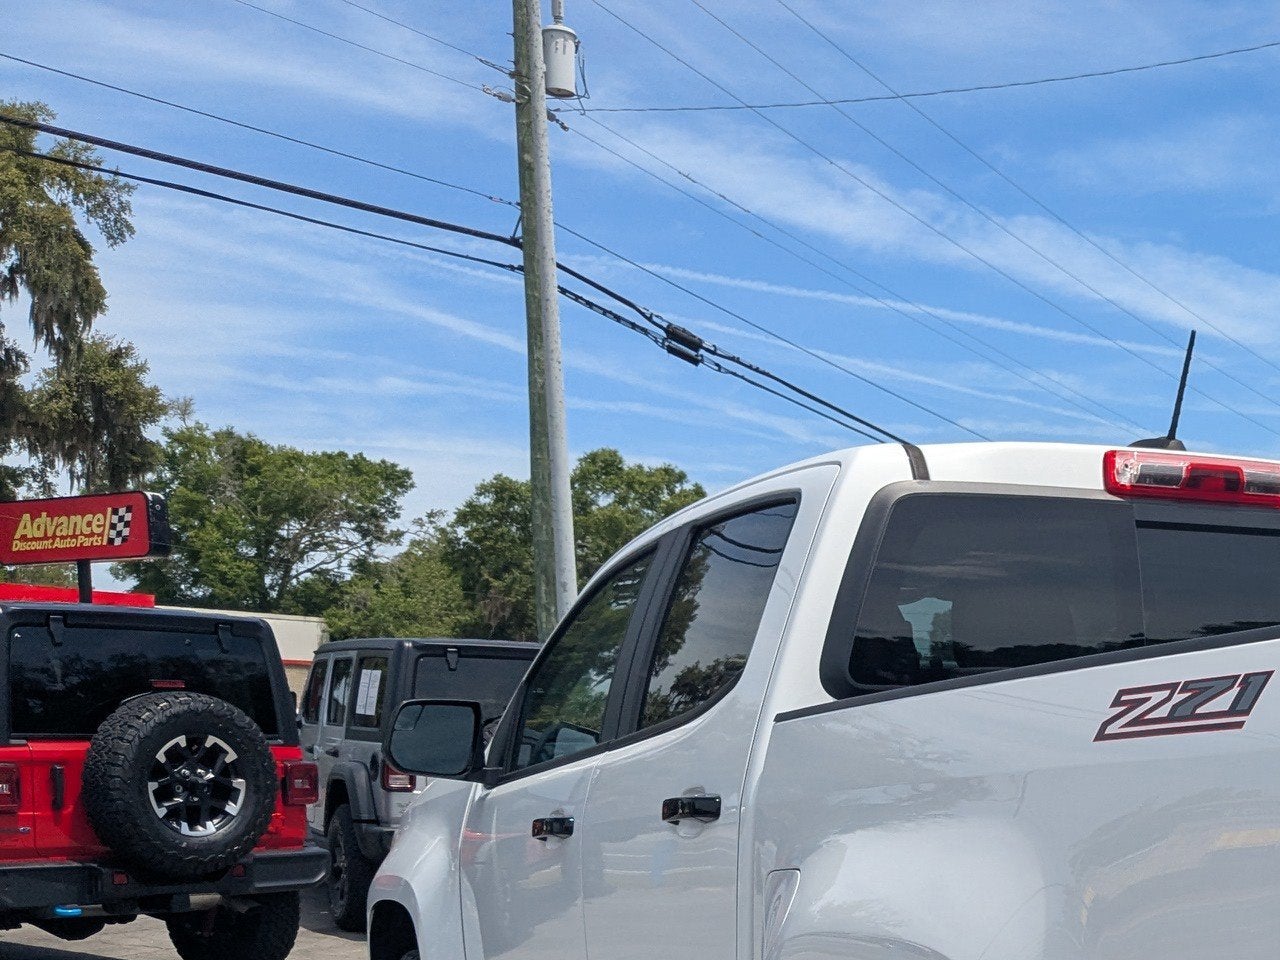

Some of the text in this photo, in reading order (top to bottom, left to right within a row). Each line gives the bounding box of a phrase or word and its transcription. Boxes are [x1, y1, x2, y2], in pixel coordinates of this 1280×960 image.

[13, 511, 105, 539] Advance
[12, 535, 102, 552] Discount Auto Parts
[1092, 670, 1275, 742] Z71
